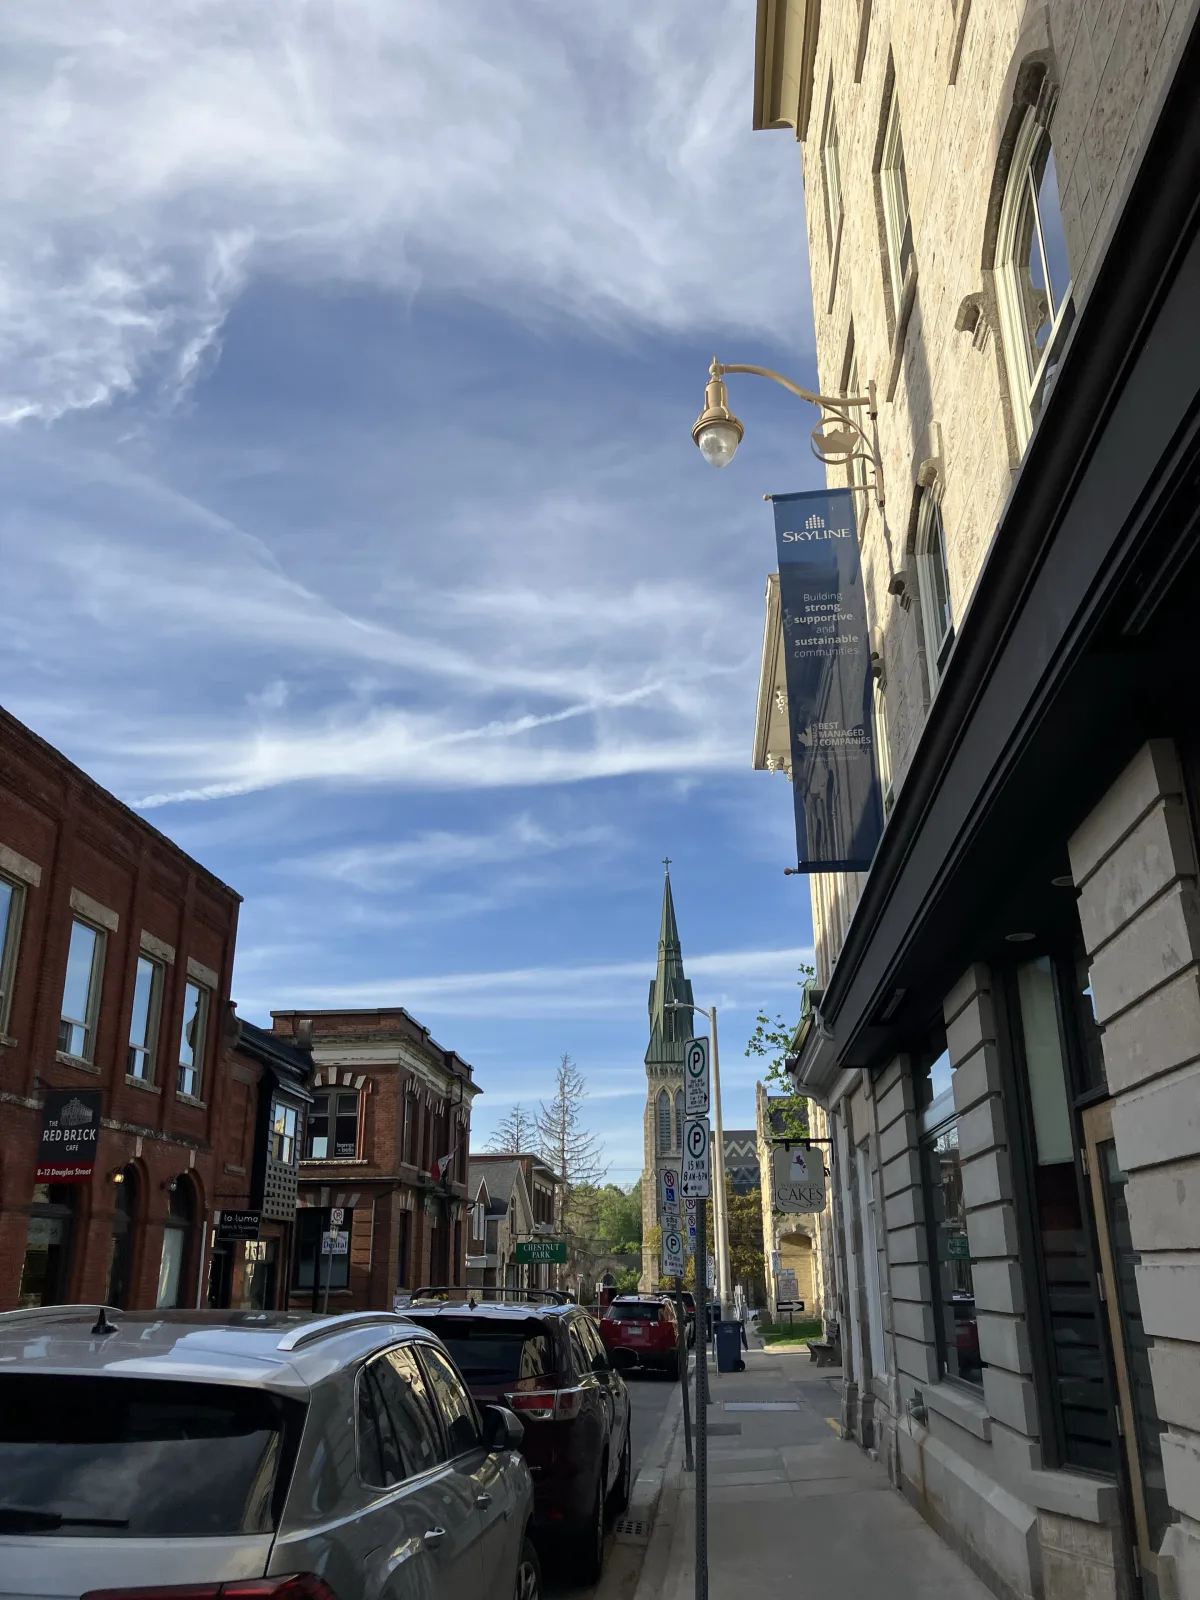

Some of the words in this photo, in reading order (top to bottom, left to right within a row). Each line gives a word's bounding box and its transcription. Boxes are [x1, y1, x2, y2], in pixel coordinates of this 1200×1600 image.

[782, 528, 852, 543] SKYLINE
[803, 592, 843, 602] Building
[816, 625, 835, 634] and
[794, 634, 859, 647] sustainable
[818, 722, 839, 730] BEST
[819, 729, 865, 738] MANAGED
[819, 737, 871, 747] COMPANIES
[693, 1051, 701, 1070] P
[43, 1130, 62, 1141] RED
[63, 1129, 96, 1141] BRICK
[693, 1131, 702, 1150] P
[688, 1160, 694, 1171] 15
[695, 1160, 705, 1170] MIN
[36, 1168, 50, 1176] 8-12
[51, 1167, 74, 1177] Douglas
[75, 1167, 92, 1175] Street
[683, 1171, 688, 1181] 8
[777, 1188, 823, 1204] CAKES
[223, 1214, 233, 1222] la
[235, 1214, 259, 1223] luma
[523, 1243, 560, 1251] CHESTNUT
[670, 1238, 676, 1249] P
[532, 1251, 551, 1259] PARK
